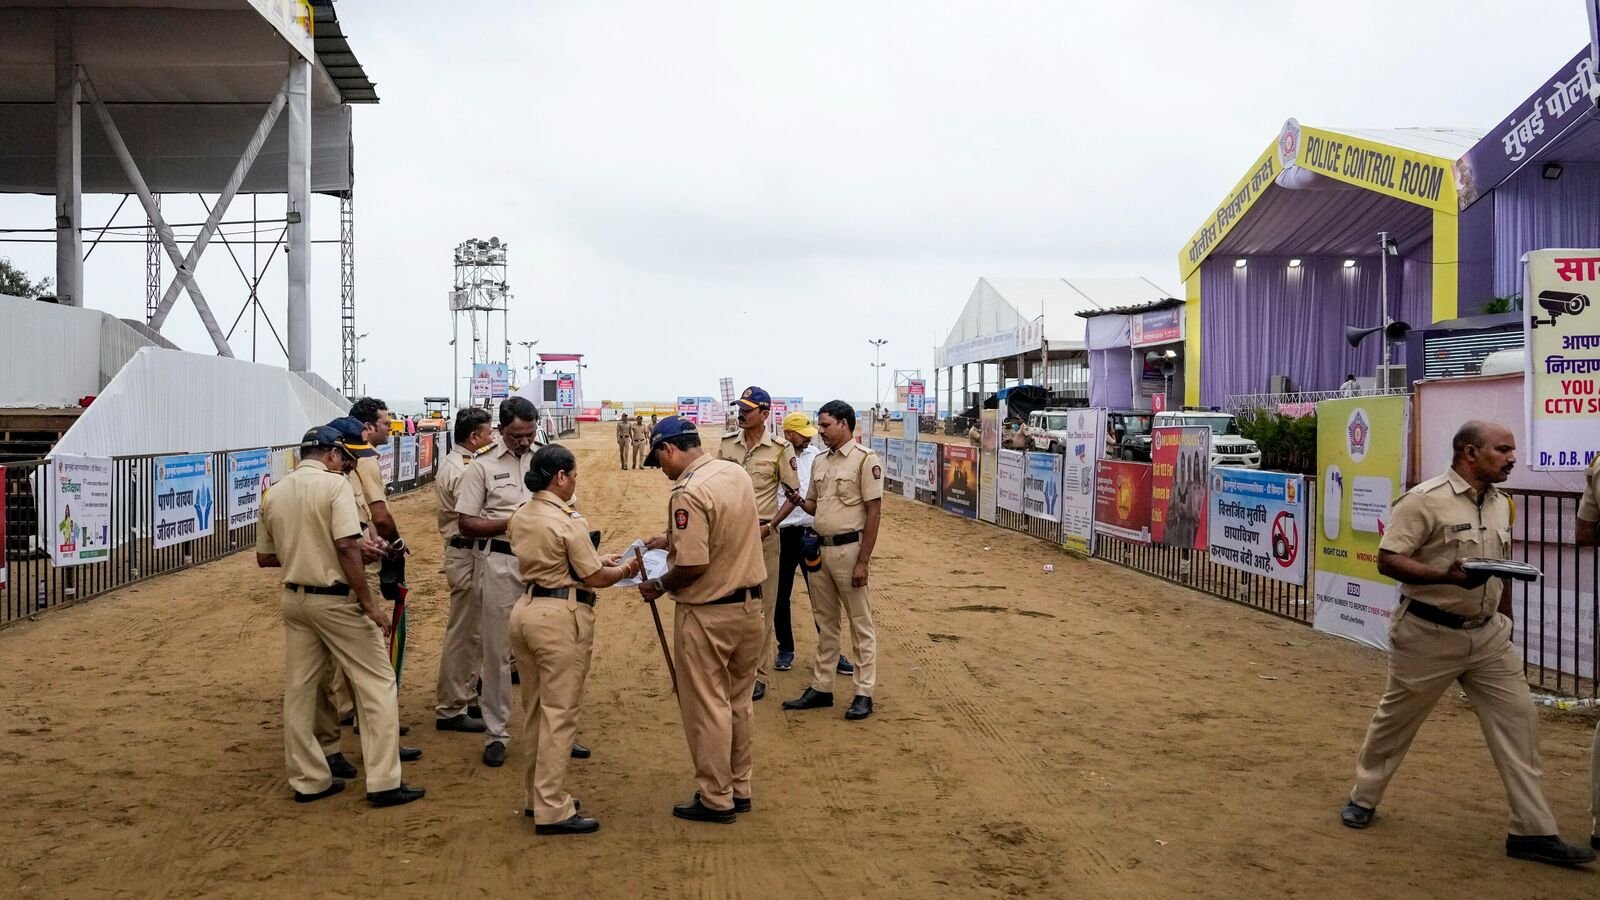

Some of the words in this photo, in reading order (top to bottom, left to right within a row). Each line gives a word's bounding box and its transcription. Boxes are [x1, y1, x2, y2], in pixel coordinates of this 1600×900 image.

[1501, 96, 1545, 162] मुंबई
[1545, 57, 1597, 119] पोली
[1304, 135, 1343, 173] POLICE
[1342, 145, 1397, 189] CONTROL
[1398, 159, 1445, 201] ROOM
[1188, 222, 1217, 263] पोलीस
[1216, 182, 1252, 234] नियंत्रण
[1251, 155, 1275, 193] कक्ष
[1554, 257, 1600, 282] सा
[1544, 355, 1600, 374] निगराण
[1561, 379, 1594, 396] YOU
[1544, 398, 1584, 414] CCTV
[1161, 433, 1180, 446] MUMBAI
[1539, 451, 1556, 466] Dr.
[1559, 451, 1581, 466] D.B.
[158, 487, 175, 511] पाणी
[176, 490, 194, 508] वाचवा
[1218, 499, 1245, 520] विसर्जित
[157, 518, 176, 541] जीवन
[177, 517, 195, 537] वाचवा
[1211, 543, 1239, 563] करण्यास
[1240, 547, 1253, 567] बंदी
[1323, 546, 1336, 556] RIGHT
[1336, 549, 1348, 558] CLICK
[1356, 552, 1372, 562] WRONG
[1348, 583, 1360, 596] 1930
